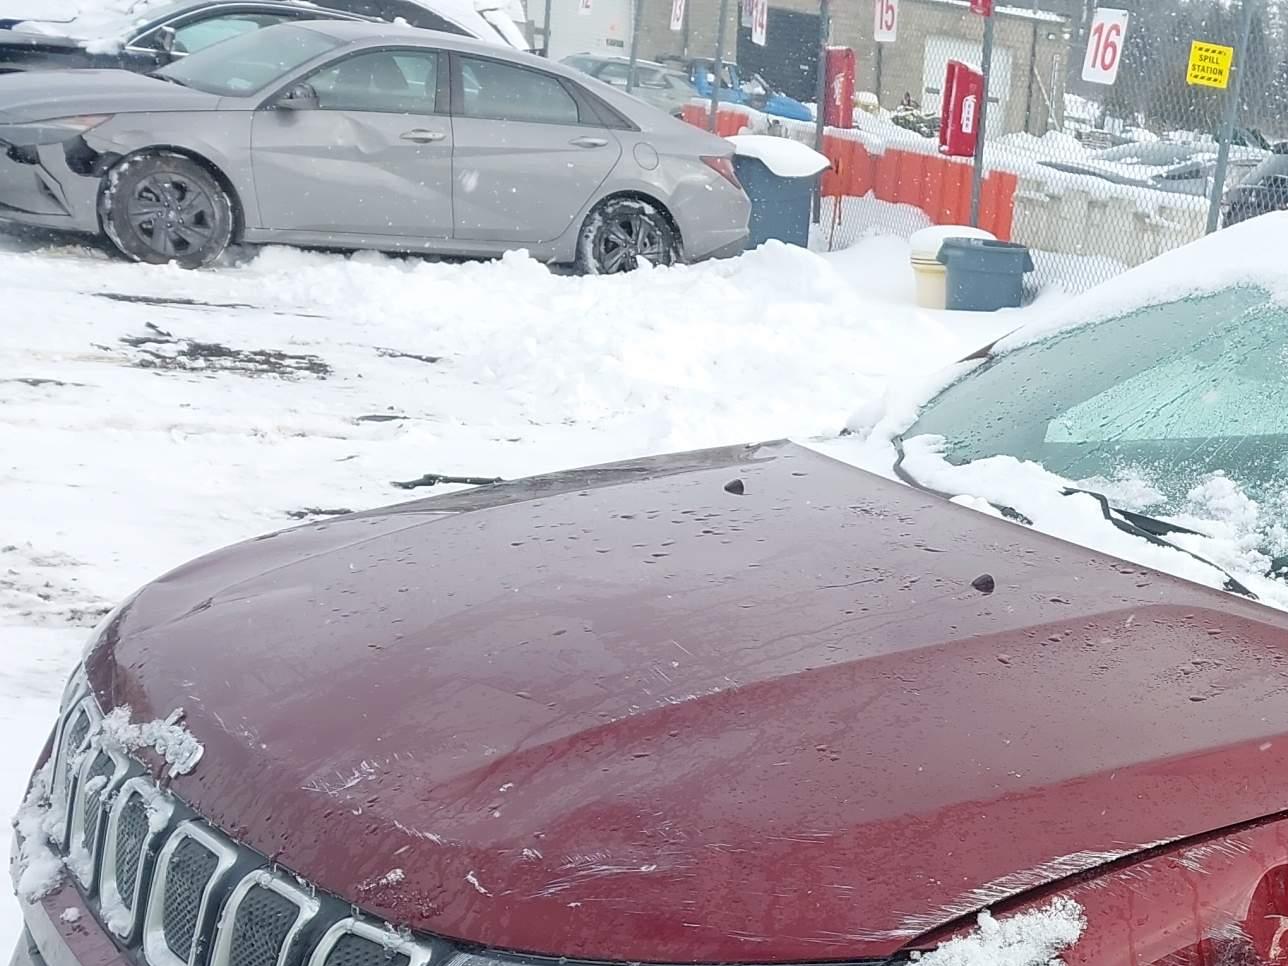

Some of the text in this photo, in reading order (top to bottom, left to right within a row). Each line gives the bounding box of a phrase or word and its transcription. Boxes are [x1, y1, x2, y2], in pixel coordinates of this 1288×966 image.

[879, 0, 895, 31] 15
[1091, 22, 1121, 71] 16
[1191, 63, 1223, 77] STATION
[1199, 54, 1220, 65] SPILL
